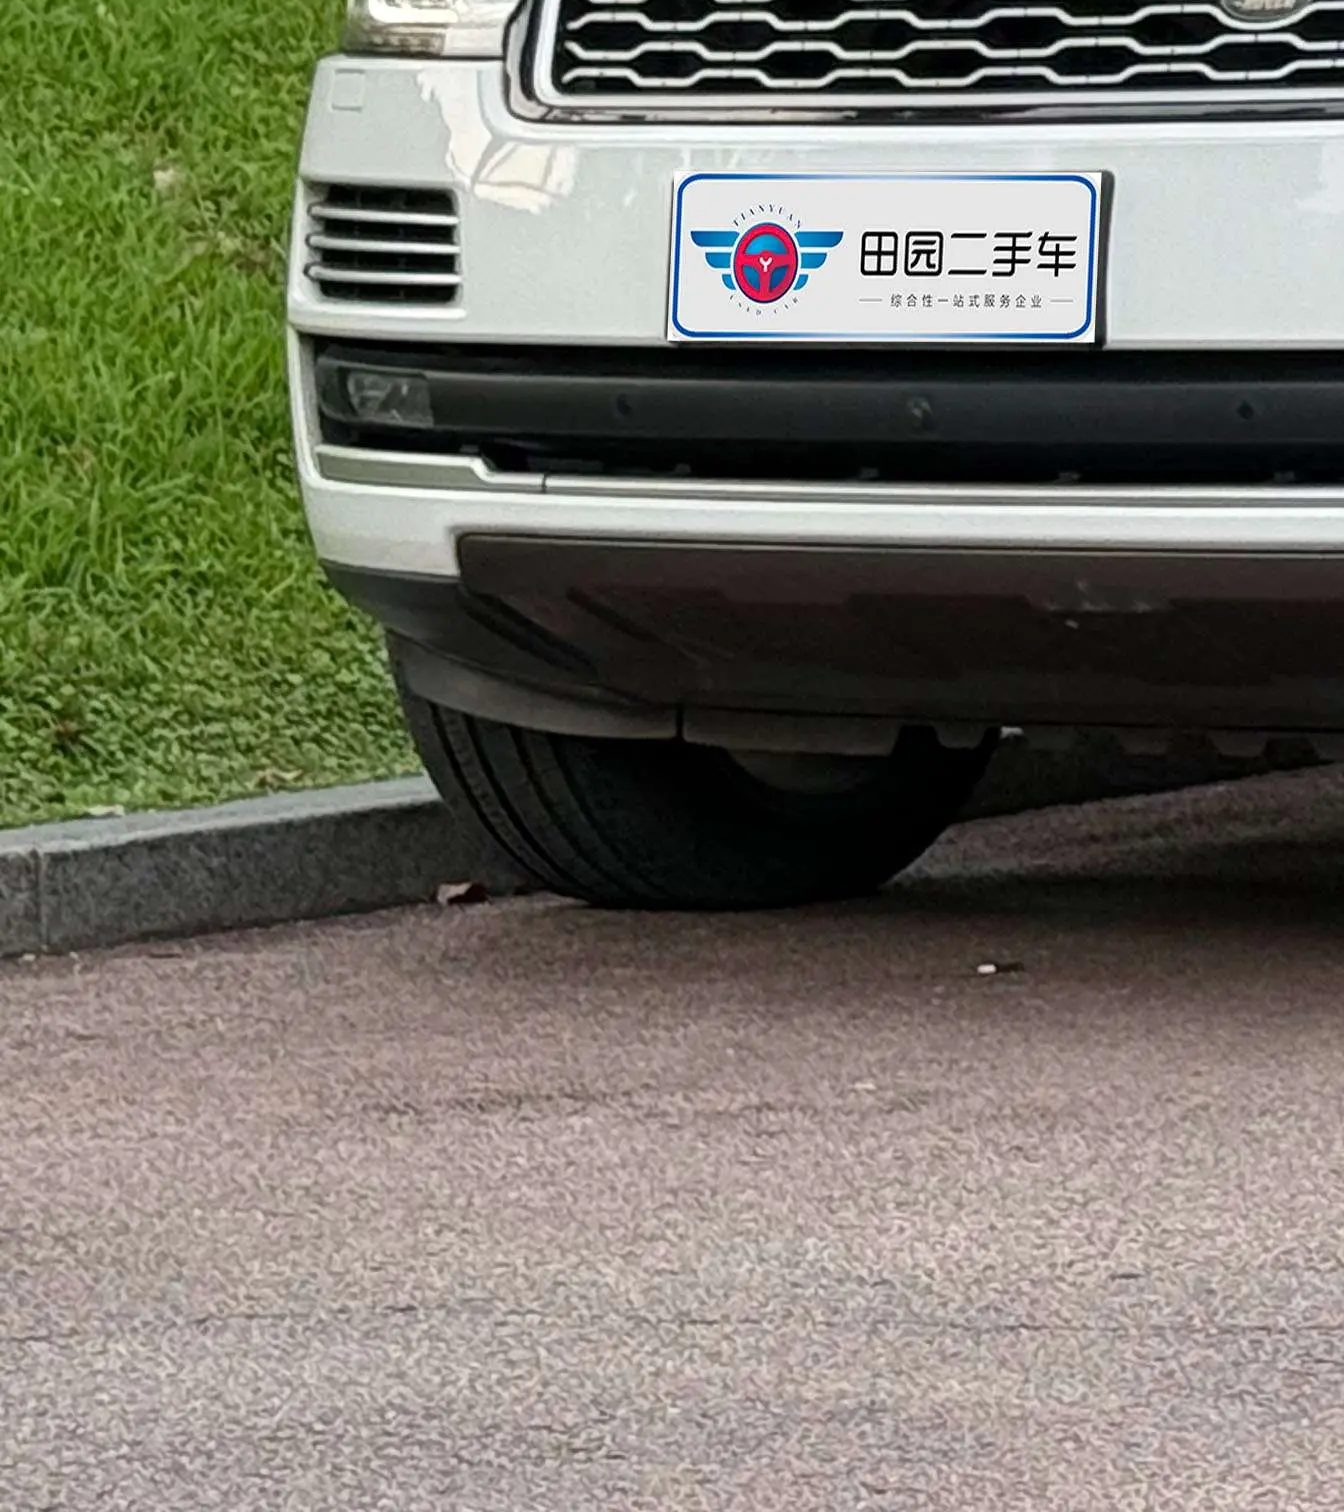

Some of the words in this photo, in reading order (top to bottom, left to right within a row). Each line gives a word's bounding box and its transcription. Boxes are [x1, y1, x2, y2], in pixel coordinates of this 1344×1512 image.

[860, 231, 1078, 277] 田园二手车
[890, 294, 1042, 308] 综合性一站式服务企业
